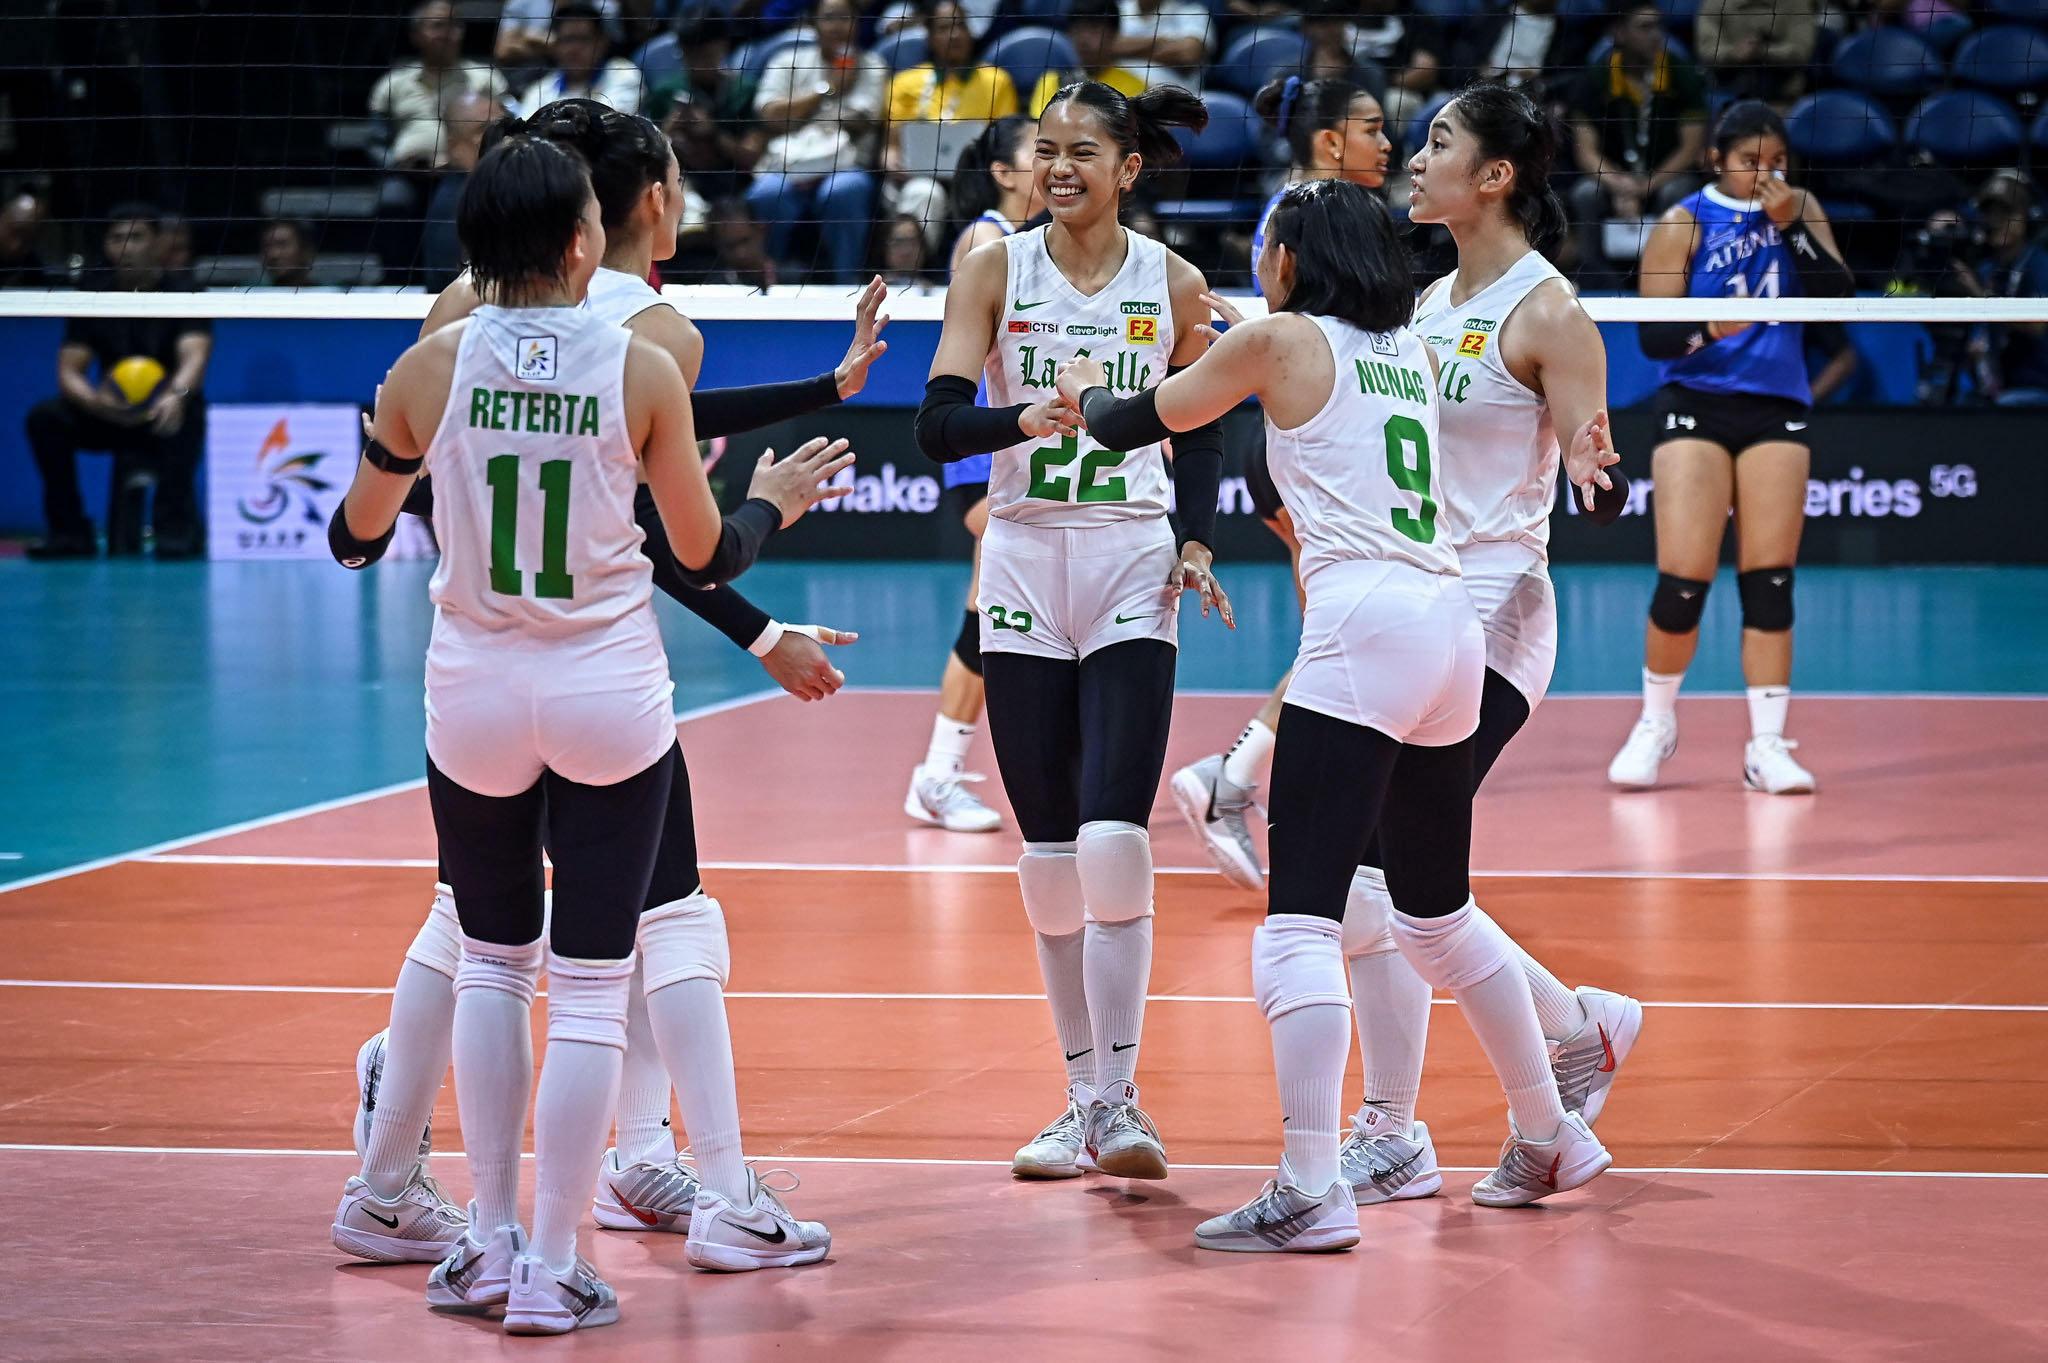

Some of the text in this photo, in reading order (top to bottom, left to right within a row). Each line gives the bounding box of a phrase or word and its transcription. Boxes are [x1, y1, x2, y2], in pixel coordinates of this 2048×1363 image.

[1122, 303, 1160, 314] nxled
[1029, 322, 1058, 333] ICTSI
[1067, 326, 1118, 337] clever light
[1130, 319, 1154, 336] F2
[1464, 321, 1495, 331] nxled
[1461, 334, 1485, 351] F2
[1019, 345, 1151, 392] La alle
[1355, 359, 1427, 406] NUNAG
[470, 388, 599, 436] RETERTA
[1665, 412, 1697, 430] 14
[1026, 425, 1127, 502] 22
[1384, 414, 1437, 544] 9
[1803, 464, 1977, 517] eries 5G
[487, 454, 573, 600] 11
[988, 605, 1032, 633] 22
